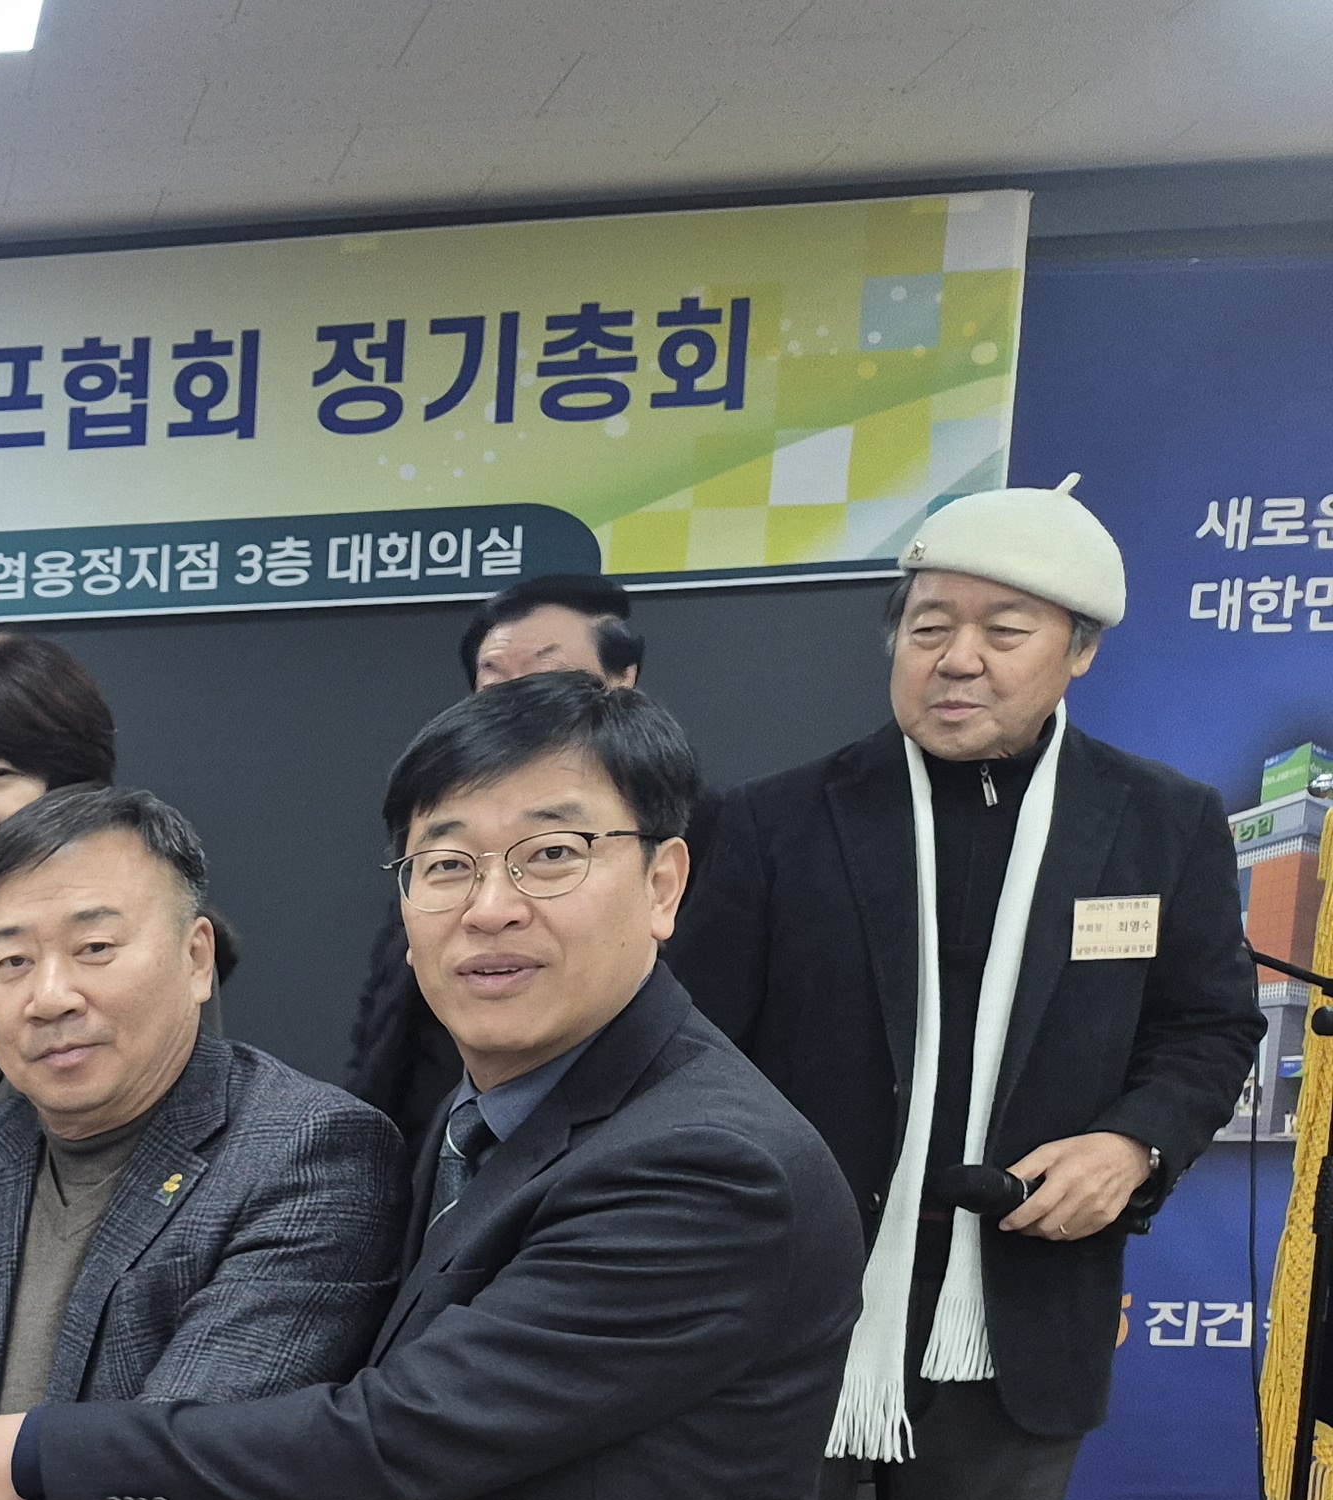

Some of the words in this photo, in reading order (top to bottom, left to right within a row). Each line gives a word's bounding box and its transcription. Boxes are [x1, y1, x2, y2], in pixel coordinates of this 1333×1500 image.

[309, 296, 752, 437] 정기총회
[234, 534, 314, 588] 3층
[326, 525, 525, 585] 대회의실
[1144, 1300, 1271, 1349] 진건
